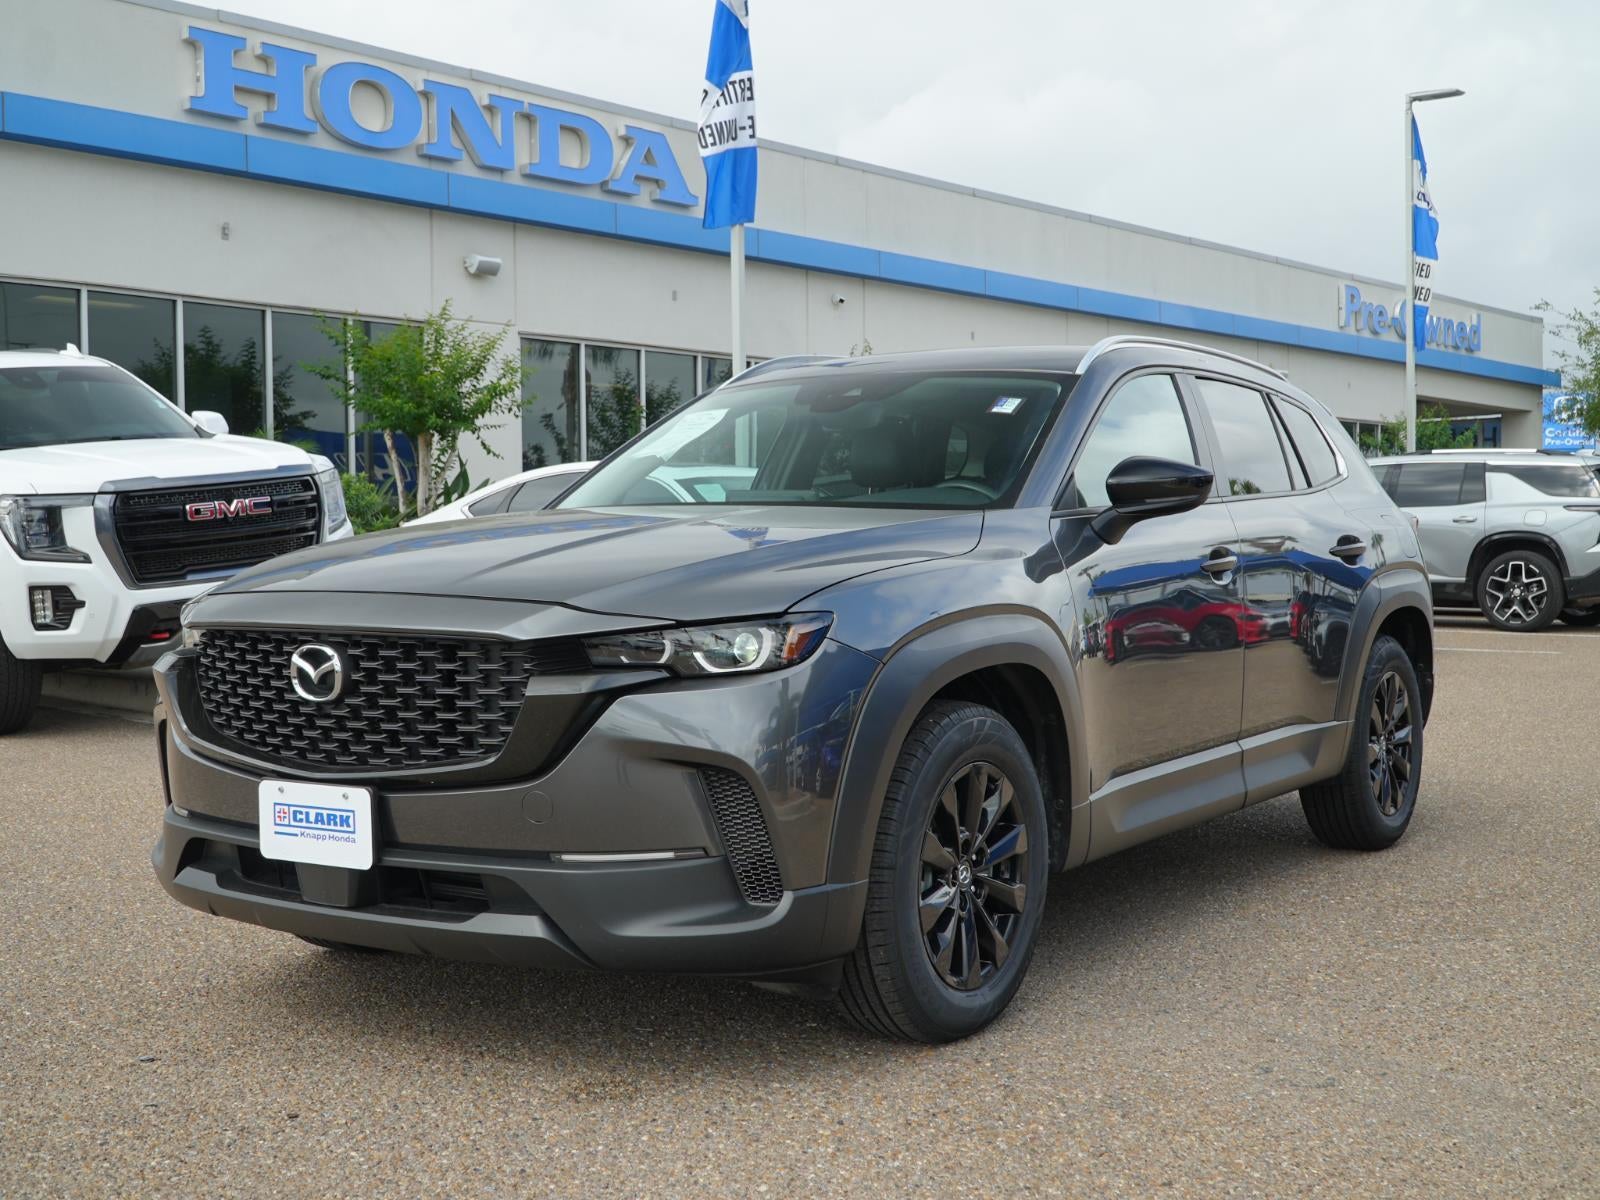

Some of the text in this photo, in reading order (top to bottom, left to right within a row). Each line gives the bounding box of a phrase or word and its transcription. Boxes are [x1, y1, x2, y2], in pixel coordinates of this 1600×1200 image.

[184, 26, 698, 207] HONDA
[1339, 284, 1482, 353] Pre-wned
[185, 496, 272, 521] GMC
[292, 809, 352, 829] CLARK
[299, 830, 356, 844] Knapp Honda
